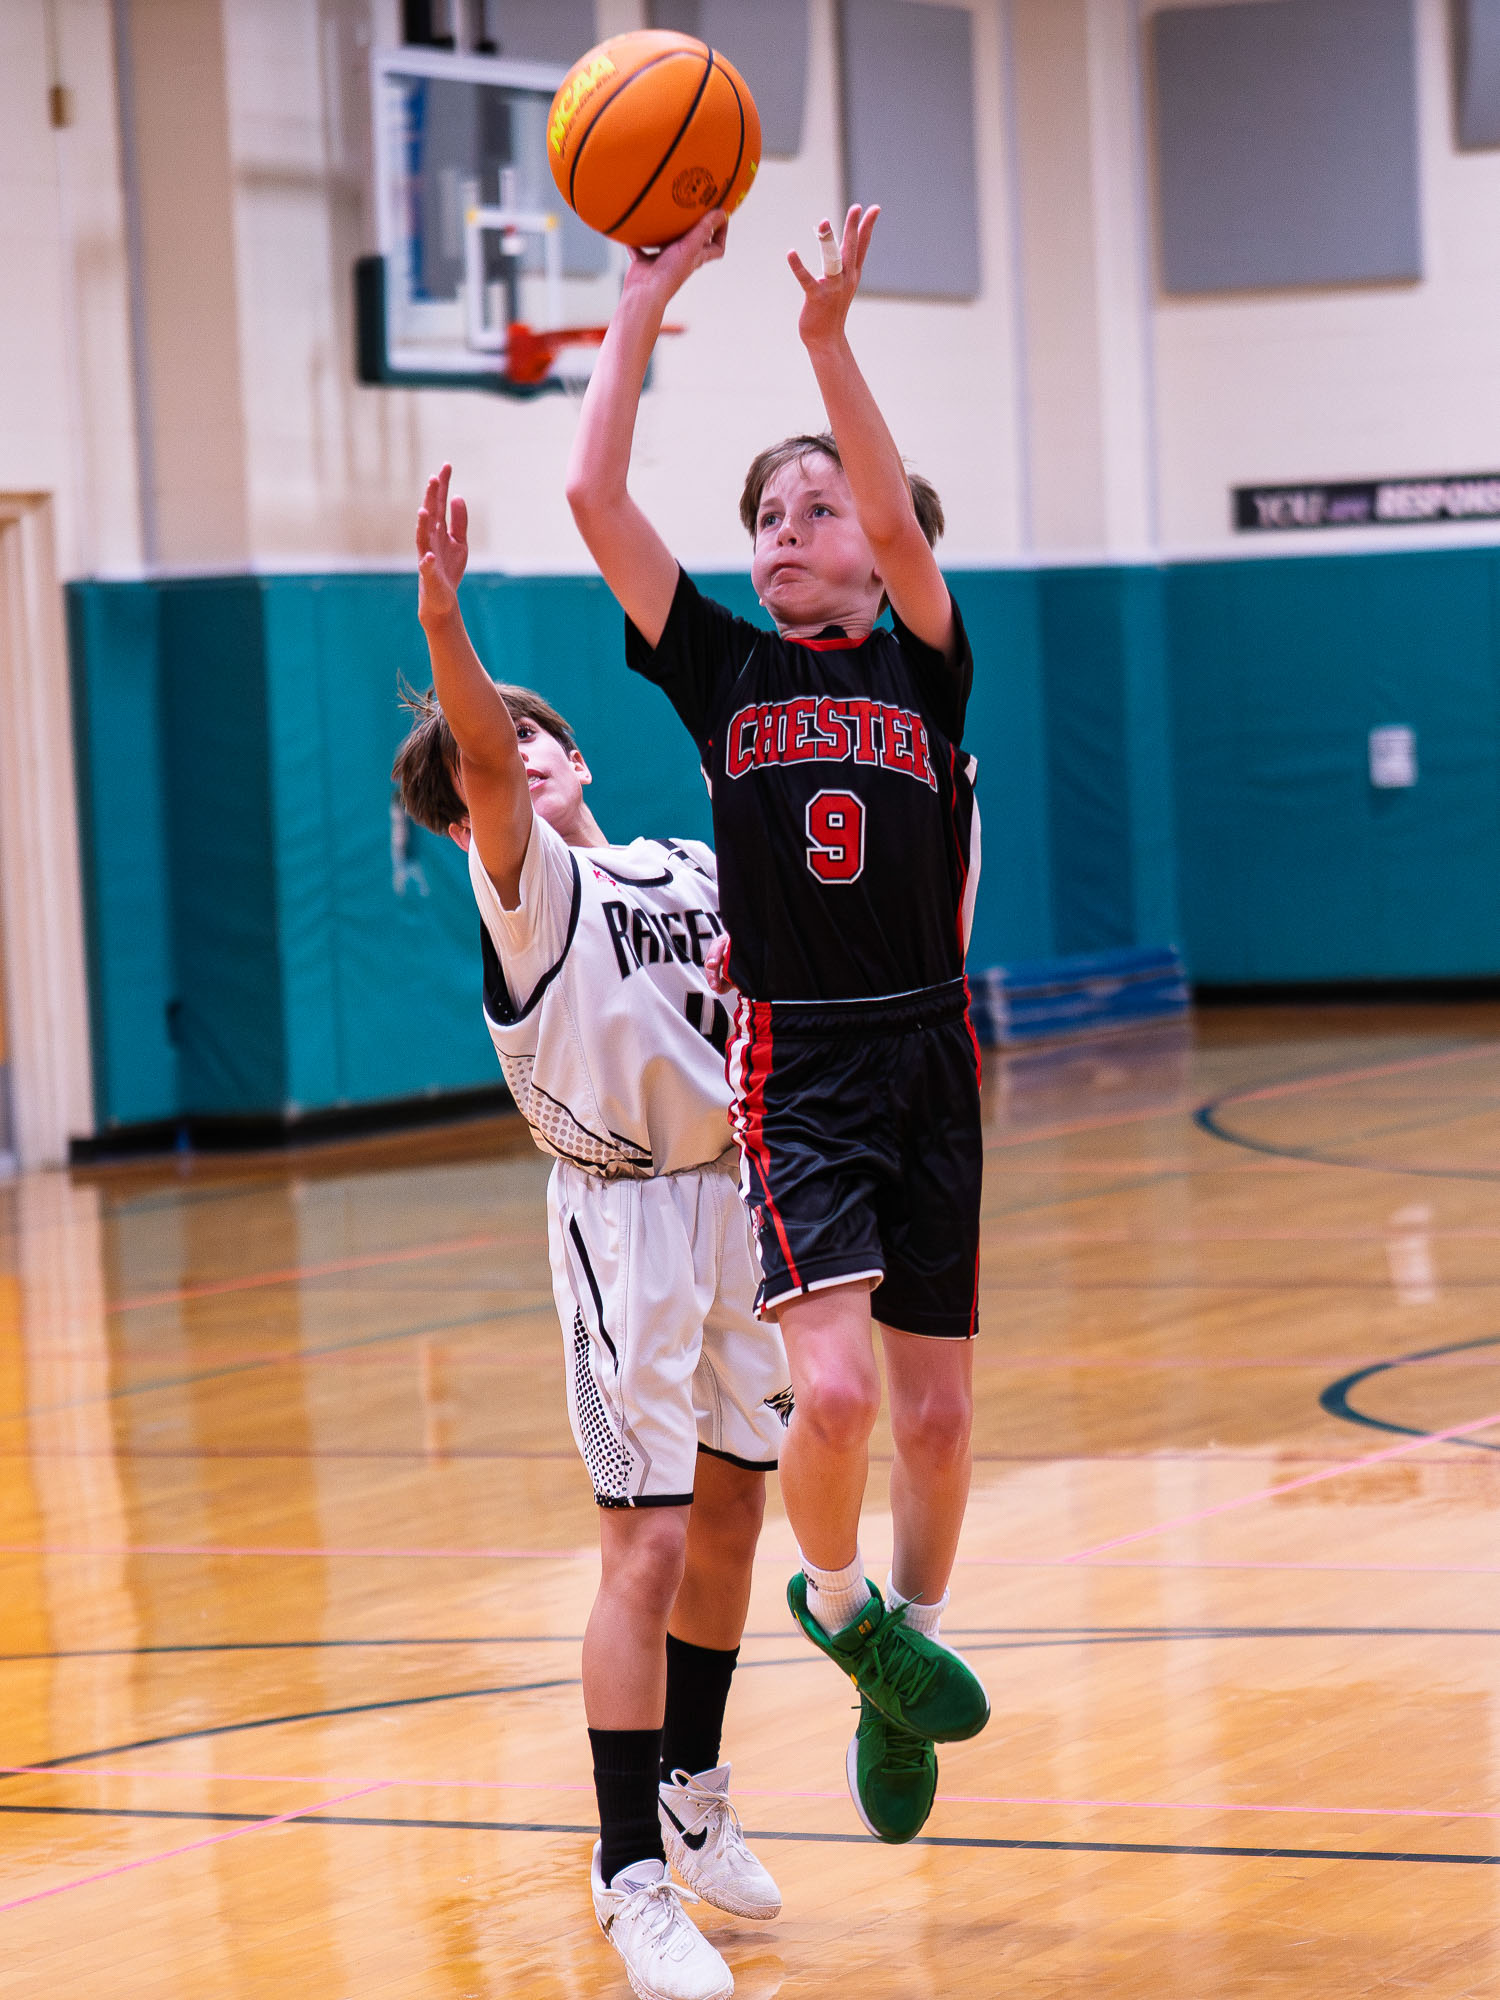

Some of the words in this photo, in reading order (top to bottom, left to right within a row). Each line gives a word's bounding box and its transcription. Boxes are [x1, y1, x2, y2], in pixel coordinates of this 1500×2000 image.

[550, 55, 616, 155] NCAA
[726, 696, 938, 793] CHESTER
[806, 789, 866, 884] 9
